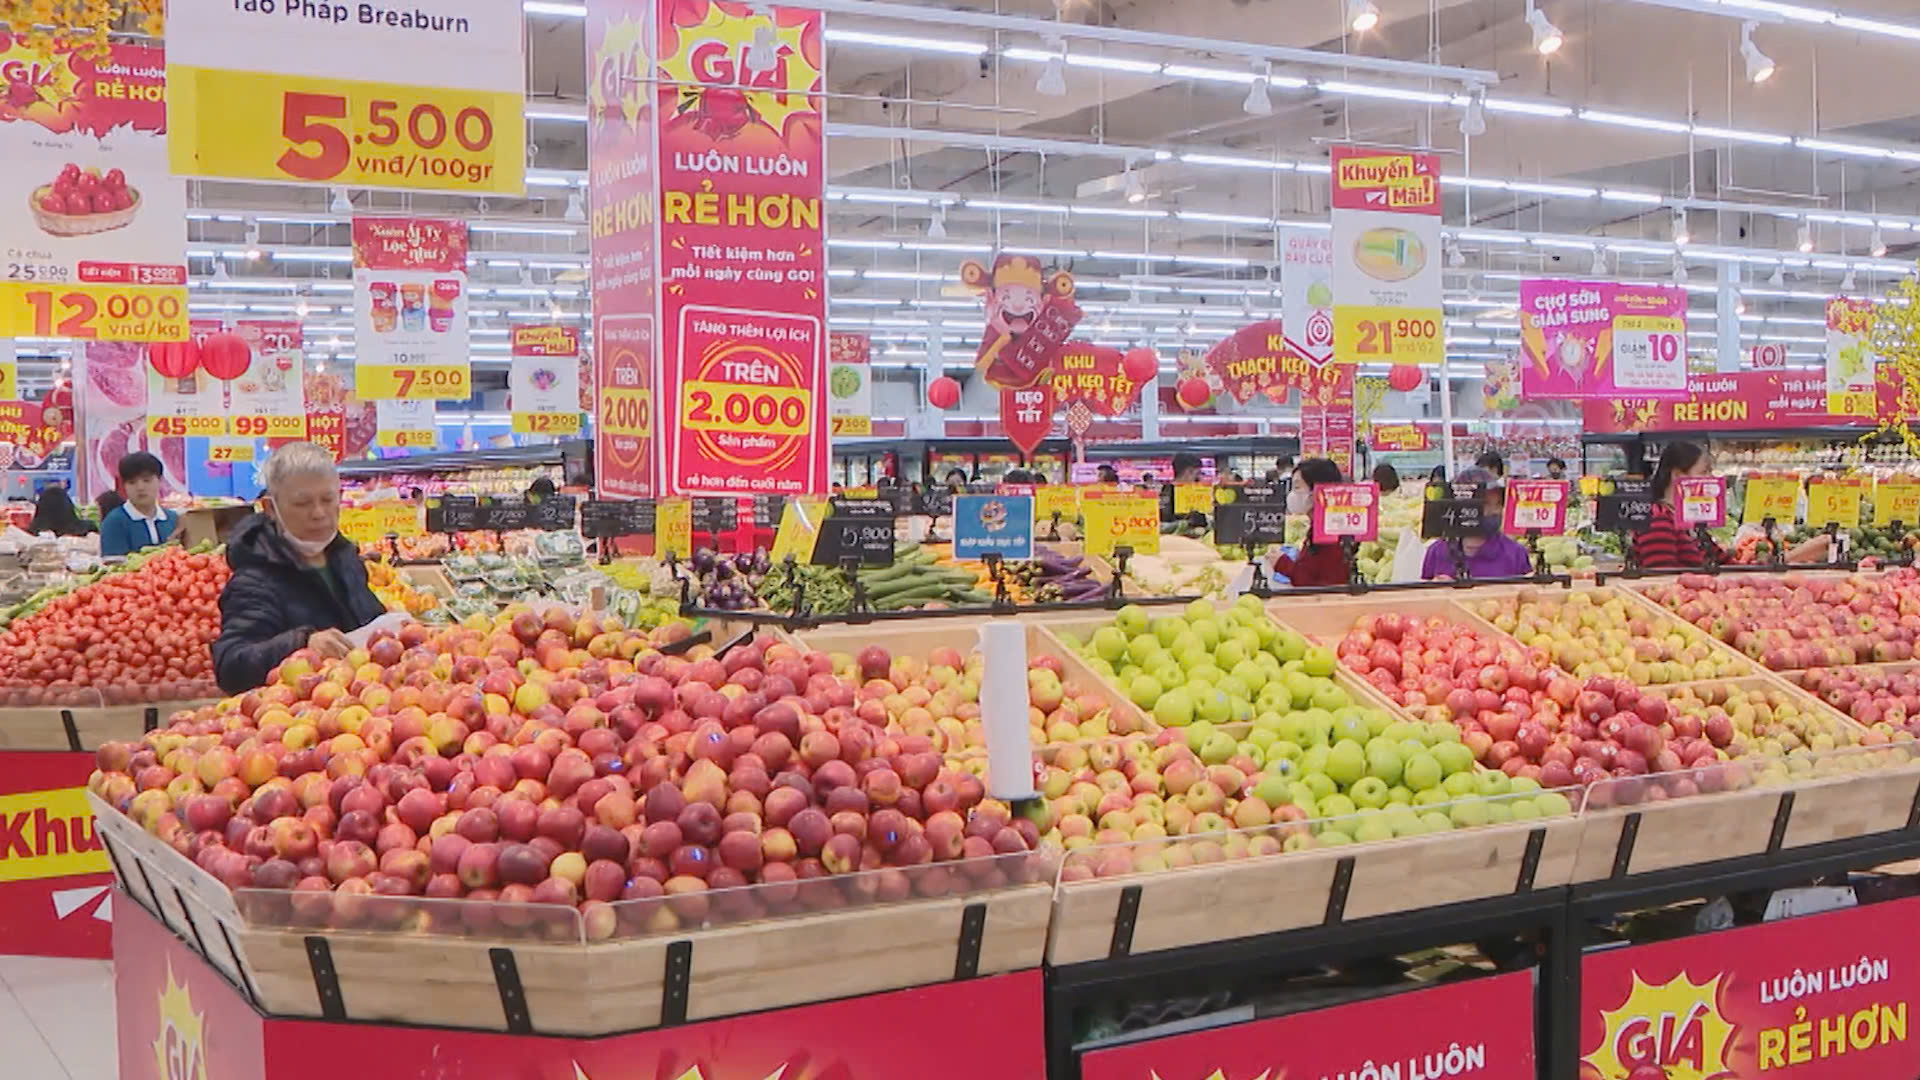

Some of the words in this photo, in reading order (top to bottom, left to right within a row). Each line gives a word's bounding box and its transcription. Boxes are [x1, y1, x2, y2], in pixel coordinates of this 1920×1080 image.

[285, 0, 349, 27] Pháp
[357, 5, 469, 33] Breaburn
[95, 78, 127, 99] RẺ
[276, 92, 492, 180] 5.500
[355, 154, 493, 185] vnđ/100gr
[675, 151, 739, 174] LUÔN
[745, 154, 808, 180] LUÔN
[1342, 159, 1410, 183] Khuyến
[664, 179, 720, 226] RẺ
[727, 192, 819, 231] HƠN
[25, 291, 178, 338] 12.000
[721, 359, 779, 384] TRÊN
[604, 396, 649, 431] 2.000
[690, 391, 806, 428] 2.000
[1673, 393, 1699, 421] RẺ
[1701, 399, 1748, 420] HƠN
[1759, 967, 1823, 1004] LUÔN
[1828, 954, 1888, 992] LUÔN
[1616, 1000, 1711, 1073] GIÁ
[1758, 1005, 1811, 1071] RẺ
[1818, 1002, 1907, 1060] HƠN
[1410, 1041, 1485, 1080] LUÔN
